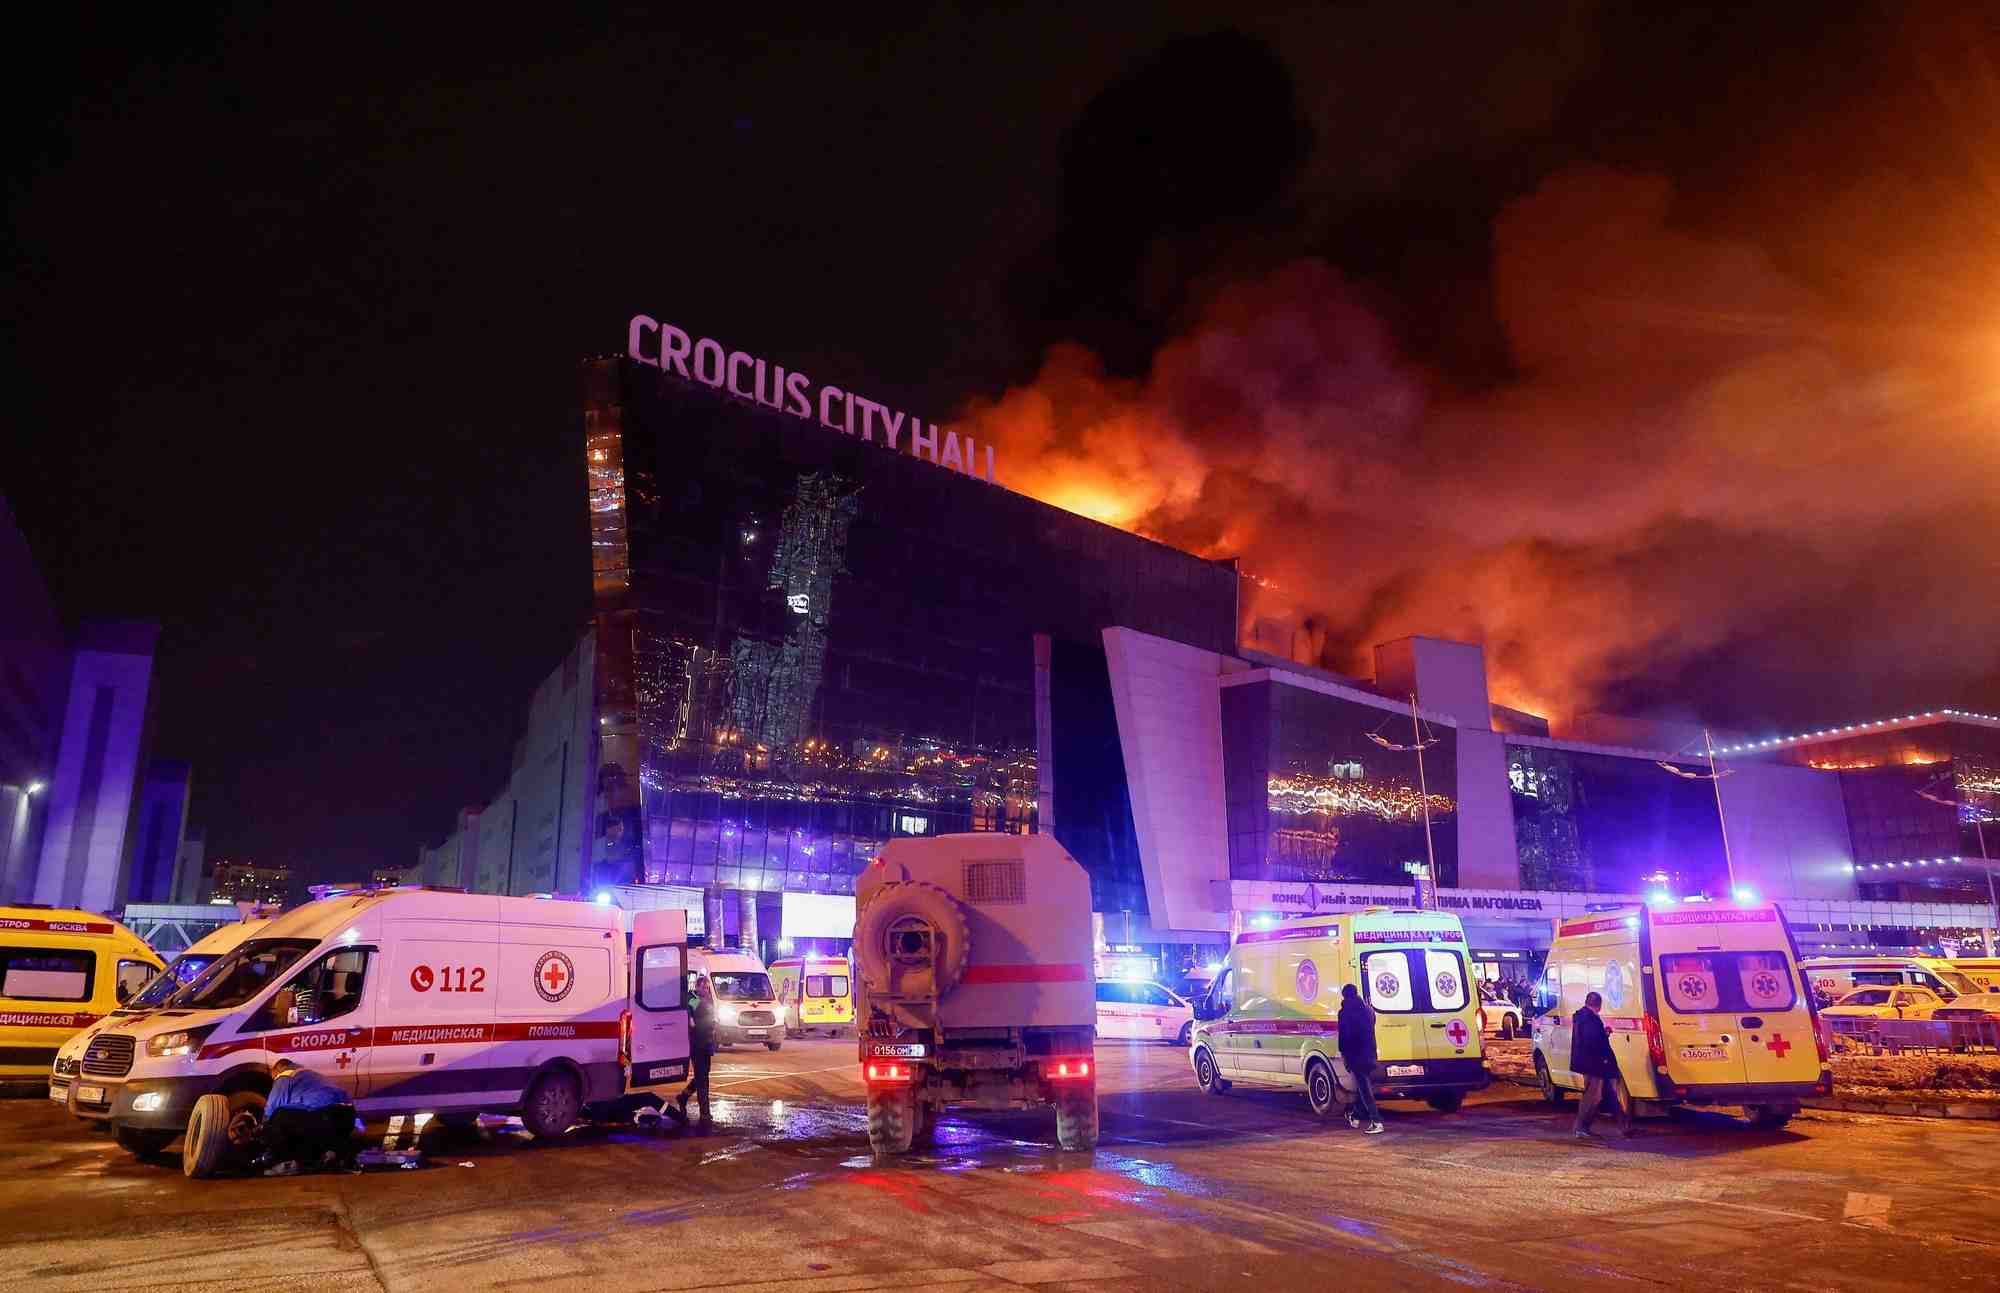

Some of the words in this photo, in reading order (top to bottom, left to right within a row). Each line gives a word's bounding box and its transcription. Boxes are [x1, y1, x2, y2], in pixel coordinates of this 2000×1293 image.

[628, 314, 812, 419] CROCUS
[819, 385, 905, 450] CITY
[911, 416, 1001, 487] HALL
[1472, 896, 1543, 911] МАГОМАЕВА
[48, 923, 88, 932] МОСКВА
[440, 966, 485, 992] 112
[1971, 976, 1990, 986] 03
[291, 1033, 347, 1048] СКОРАЯ
[391, 1027, 484, 1042] МЕДИЦИНСКАЯ
[528, 1025, 576, 1037] ПОМОЩЬ
